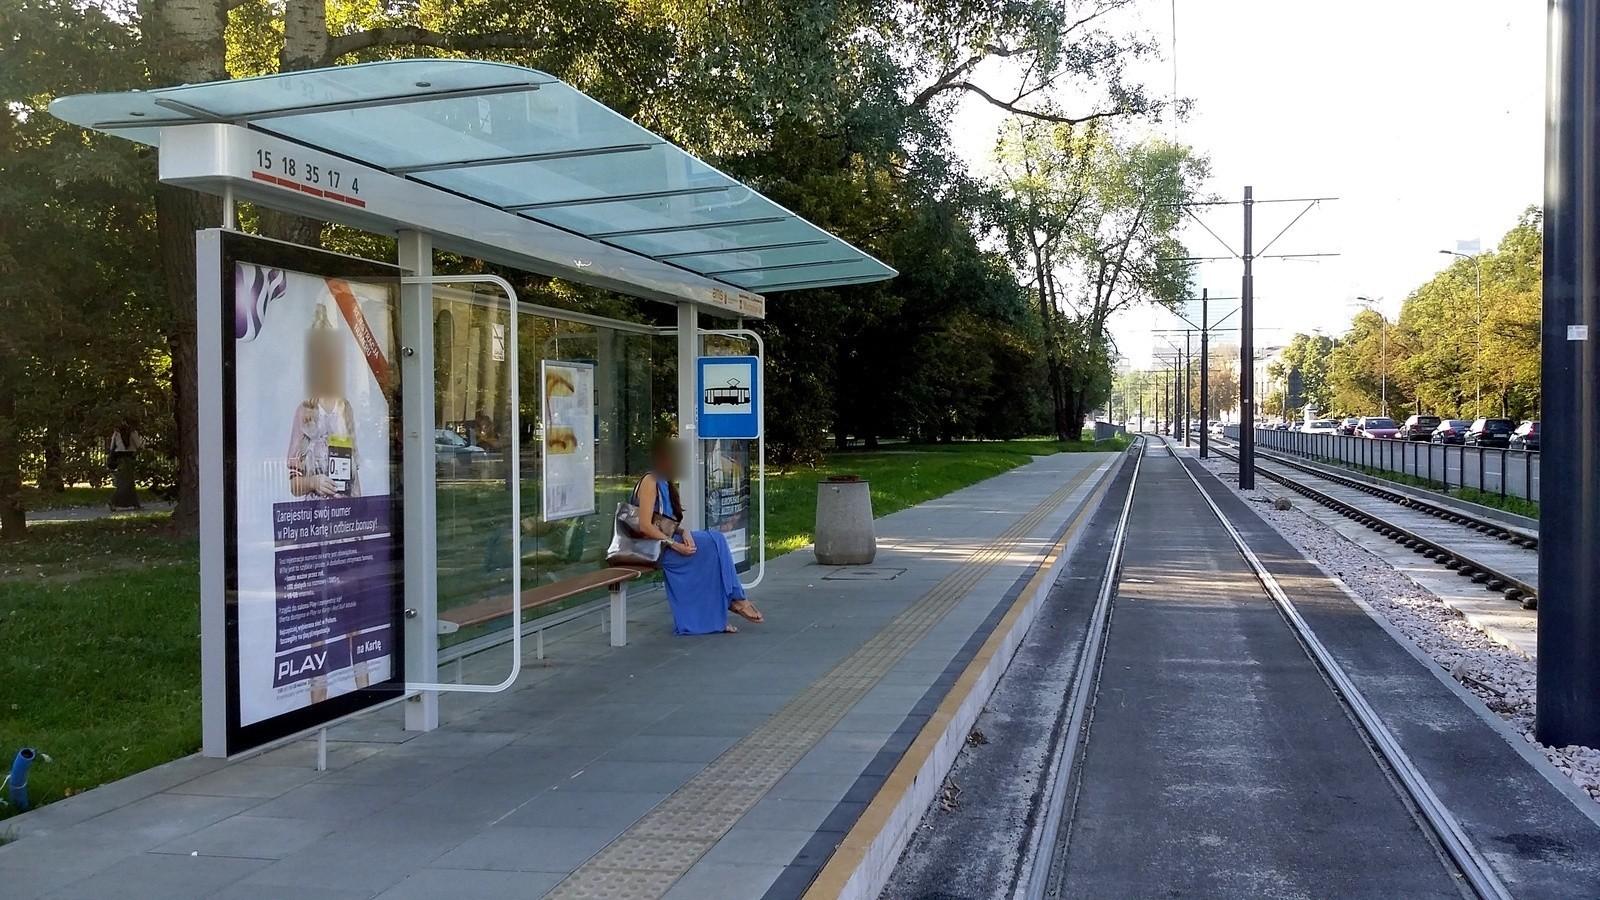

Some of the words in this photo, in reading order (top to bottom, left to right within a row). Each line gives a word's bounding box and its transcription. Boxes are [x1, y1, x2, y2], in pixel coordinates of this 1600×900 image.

[256, 148, 272, 170] 15
[281, 156, 297, 177] 18
[305, 163, 320, 184] 35
[327, 169, 341, 189] 17
[352, 177, 359, 194] 4
[277, 508, 313, 524] Zarejestruj
[314, 506, 330, 520] swój
[331, 506, 352, 518] numer
[283, 527, 298, 541] Play
[299, 527, 309, 538] na
[310, 524, 329, 538] Kartę
[333, 520, 355, 533] odbierz
[356, 645, 365, 655] na
[365, 639, 382, 654] Kartę
[278, 651, 327, 680] PLAY
